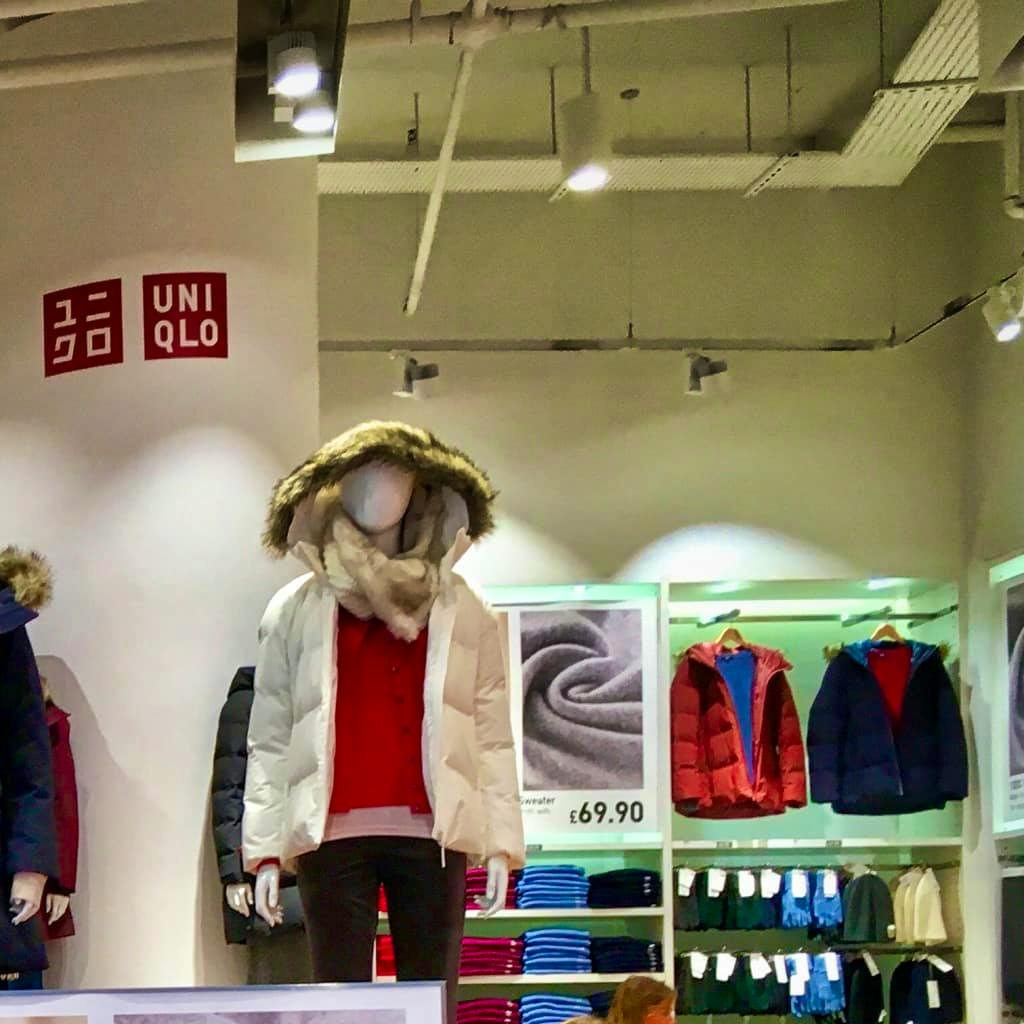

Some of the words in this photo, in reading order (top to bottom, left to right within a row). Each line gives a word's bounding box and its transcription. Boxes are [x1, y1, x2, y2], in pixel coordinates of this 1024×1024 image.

[153, 283, 212, 313] UNI
[154, 318, 219, 354] QLO
[569, 800, 644, 824] £69.90
